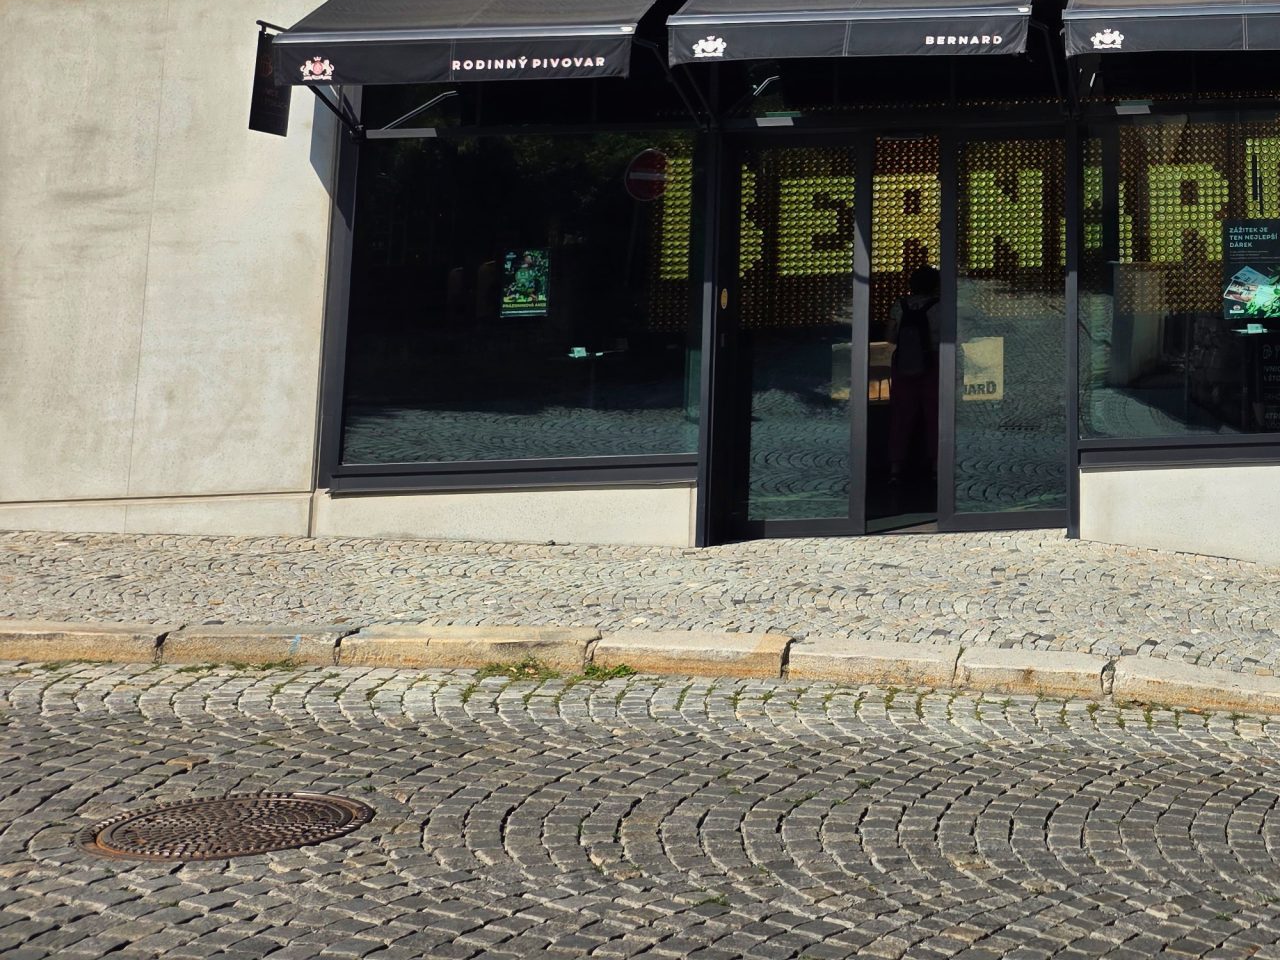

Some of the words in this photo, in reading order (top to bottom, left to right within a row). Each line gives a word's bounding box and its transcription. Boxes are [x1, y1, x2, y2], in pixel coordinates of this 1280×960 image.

[925, 35, 1003, 45] BERNARD
[452, 56, 528, 70] RODINNÝ
[532, 57, 605, 68] PIVOVAR
[1244, 232, 1278, 240] NEJLEPŠÍ
